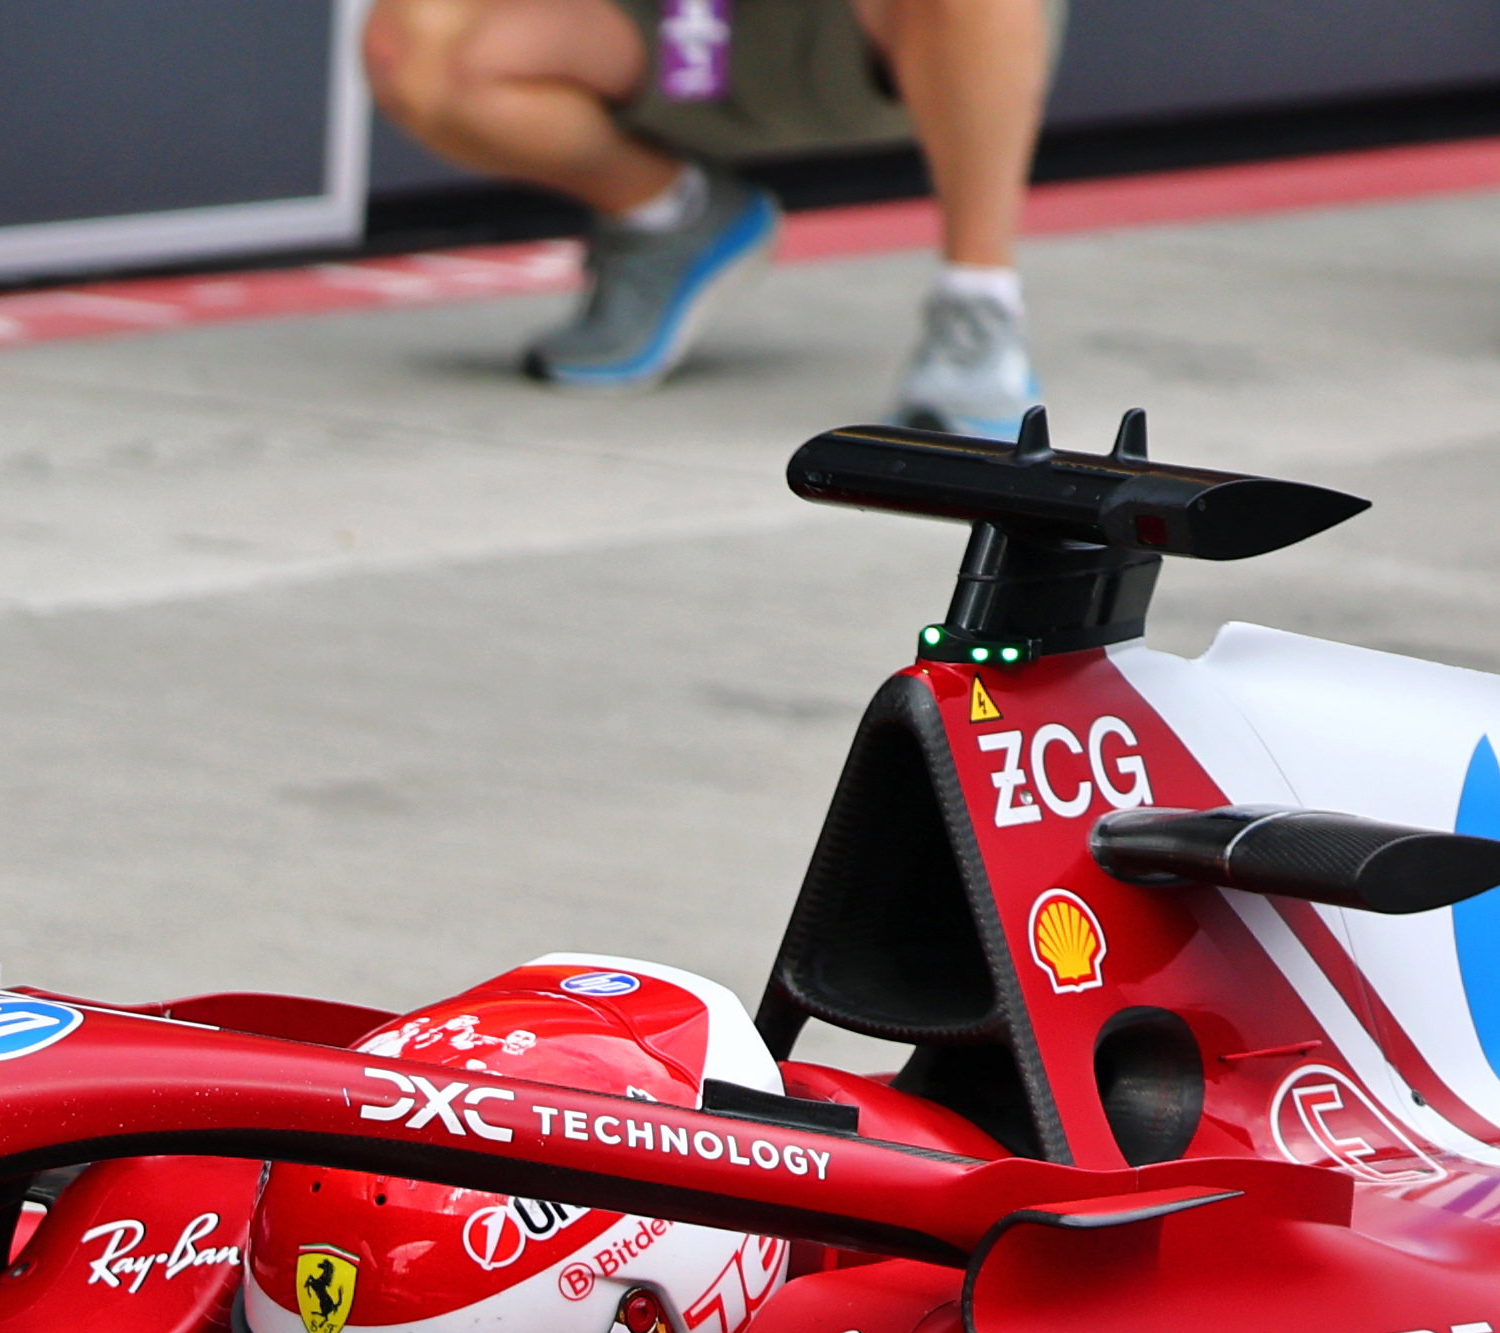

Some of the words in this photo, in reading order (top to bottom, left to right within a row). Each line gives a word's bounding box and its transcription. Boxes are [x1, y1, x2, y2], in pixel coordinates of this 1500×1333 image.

[978, 716, 1154, 829] ZCG
[360, 1067, 515, 1142] DXC
[532, 1104, 831, 1181] TECHNOLOGY
